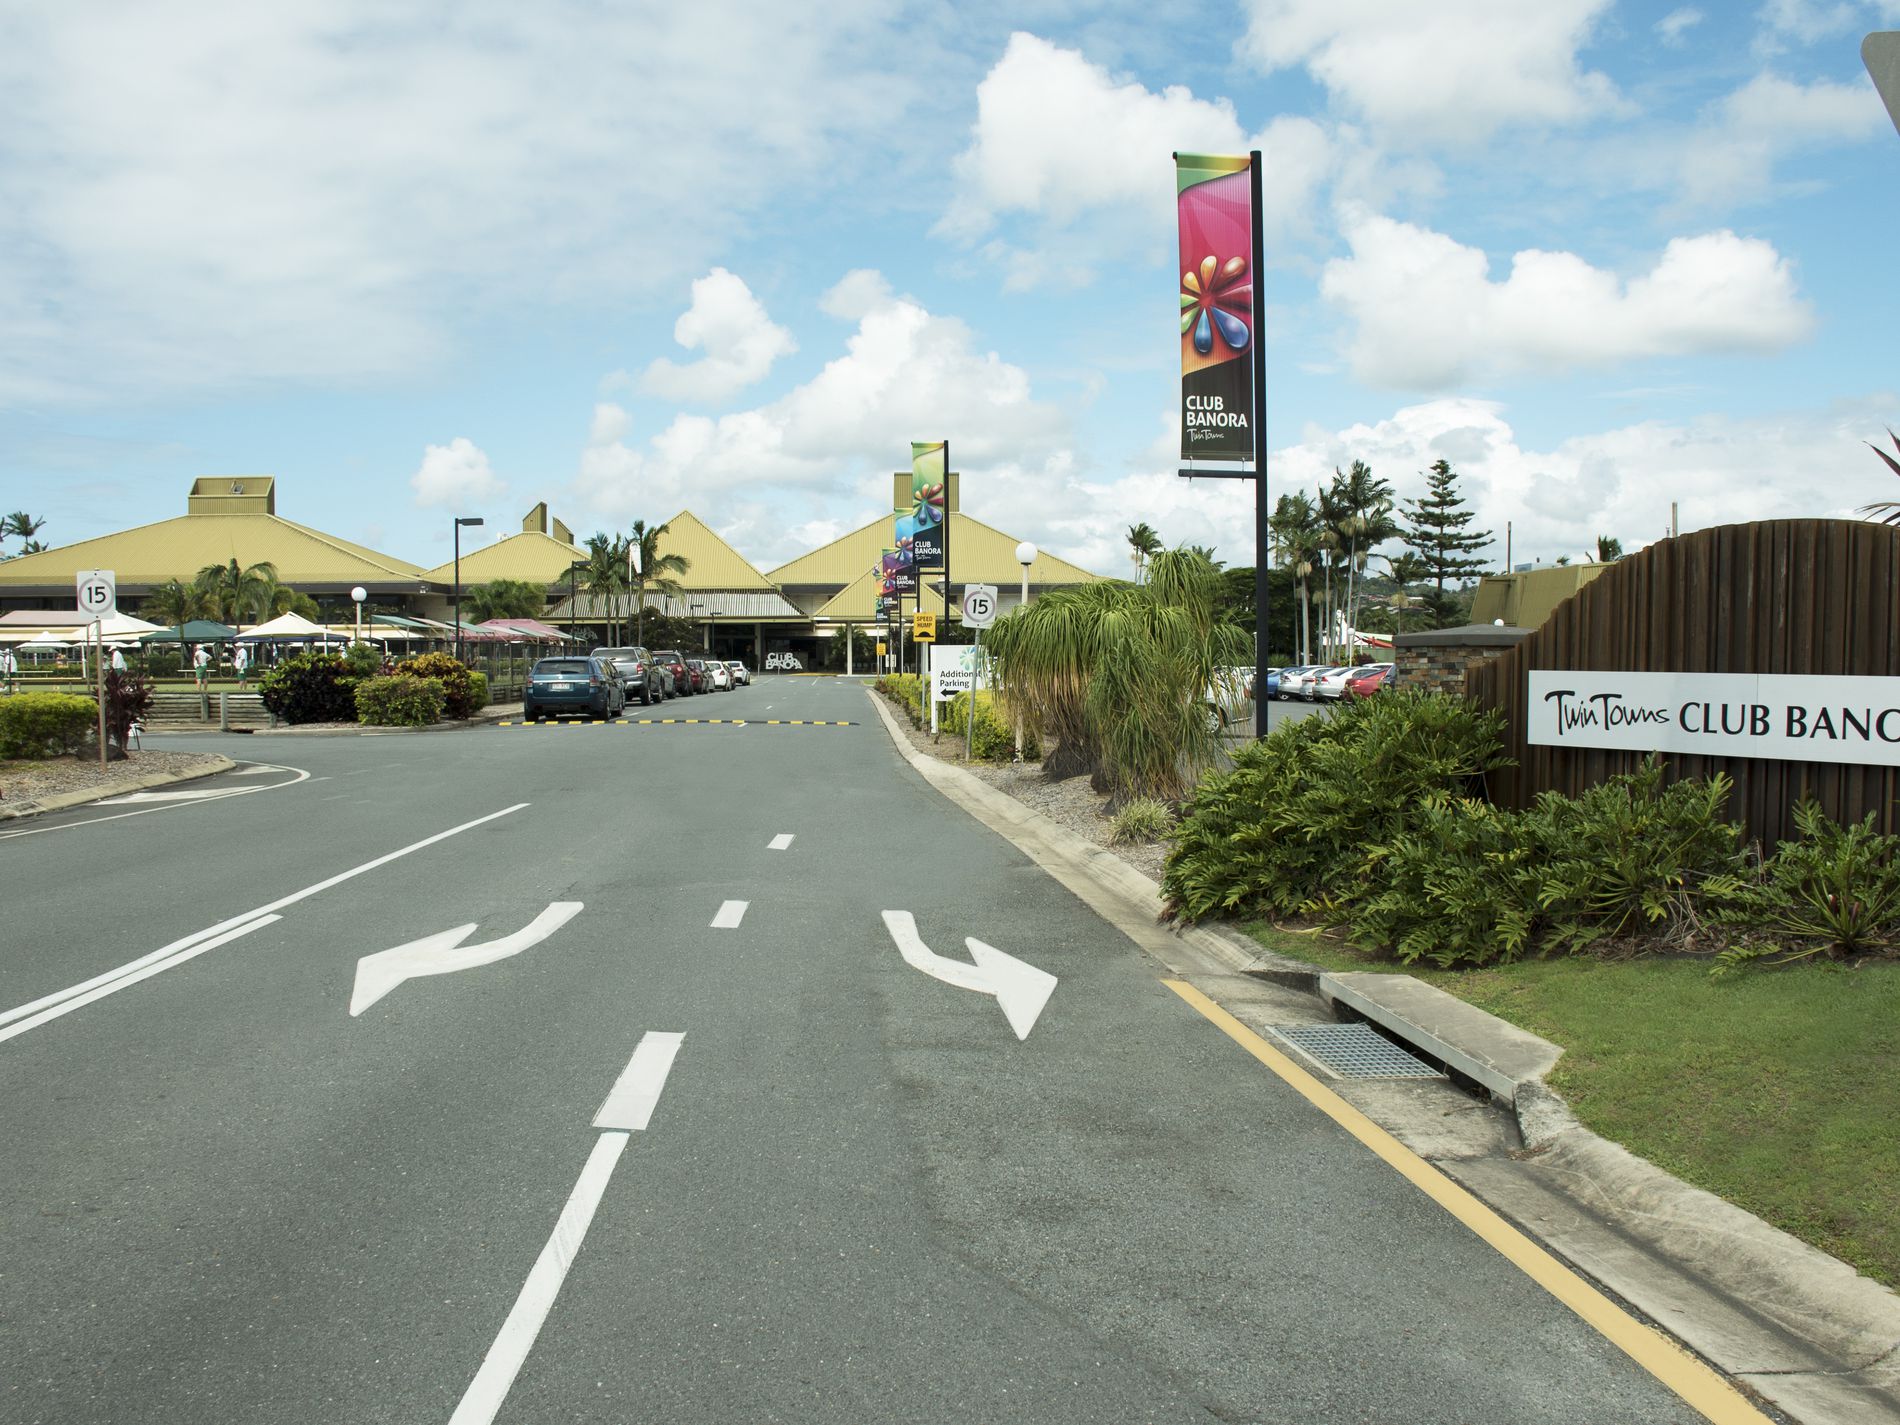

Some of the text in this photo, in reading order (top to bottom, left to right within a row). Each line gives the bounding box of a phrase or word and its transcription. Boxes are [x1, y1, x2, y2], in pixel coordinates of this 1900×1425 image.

[1186, 395, 1224, 410] CLUB
[1186, 411, 1248, 428] BANORA
[87, 586, 106, 604] 15
[972, 598, 989, 615] 15
[767, 652, 793, 660] CLUB
[765, 659, 803, 670] BANORA
[940, 670, 981, 678] Additionl
[940, 679, 970, 689] Parking
[1679, 702, 1770, 736] CLUB
